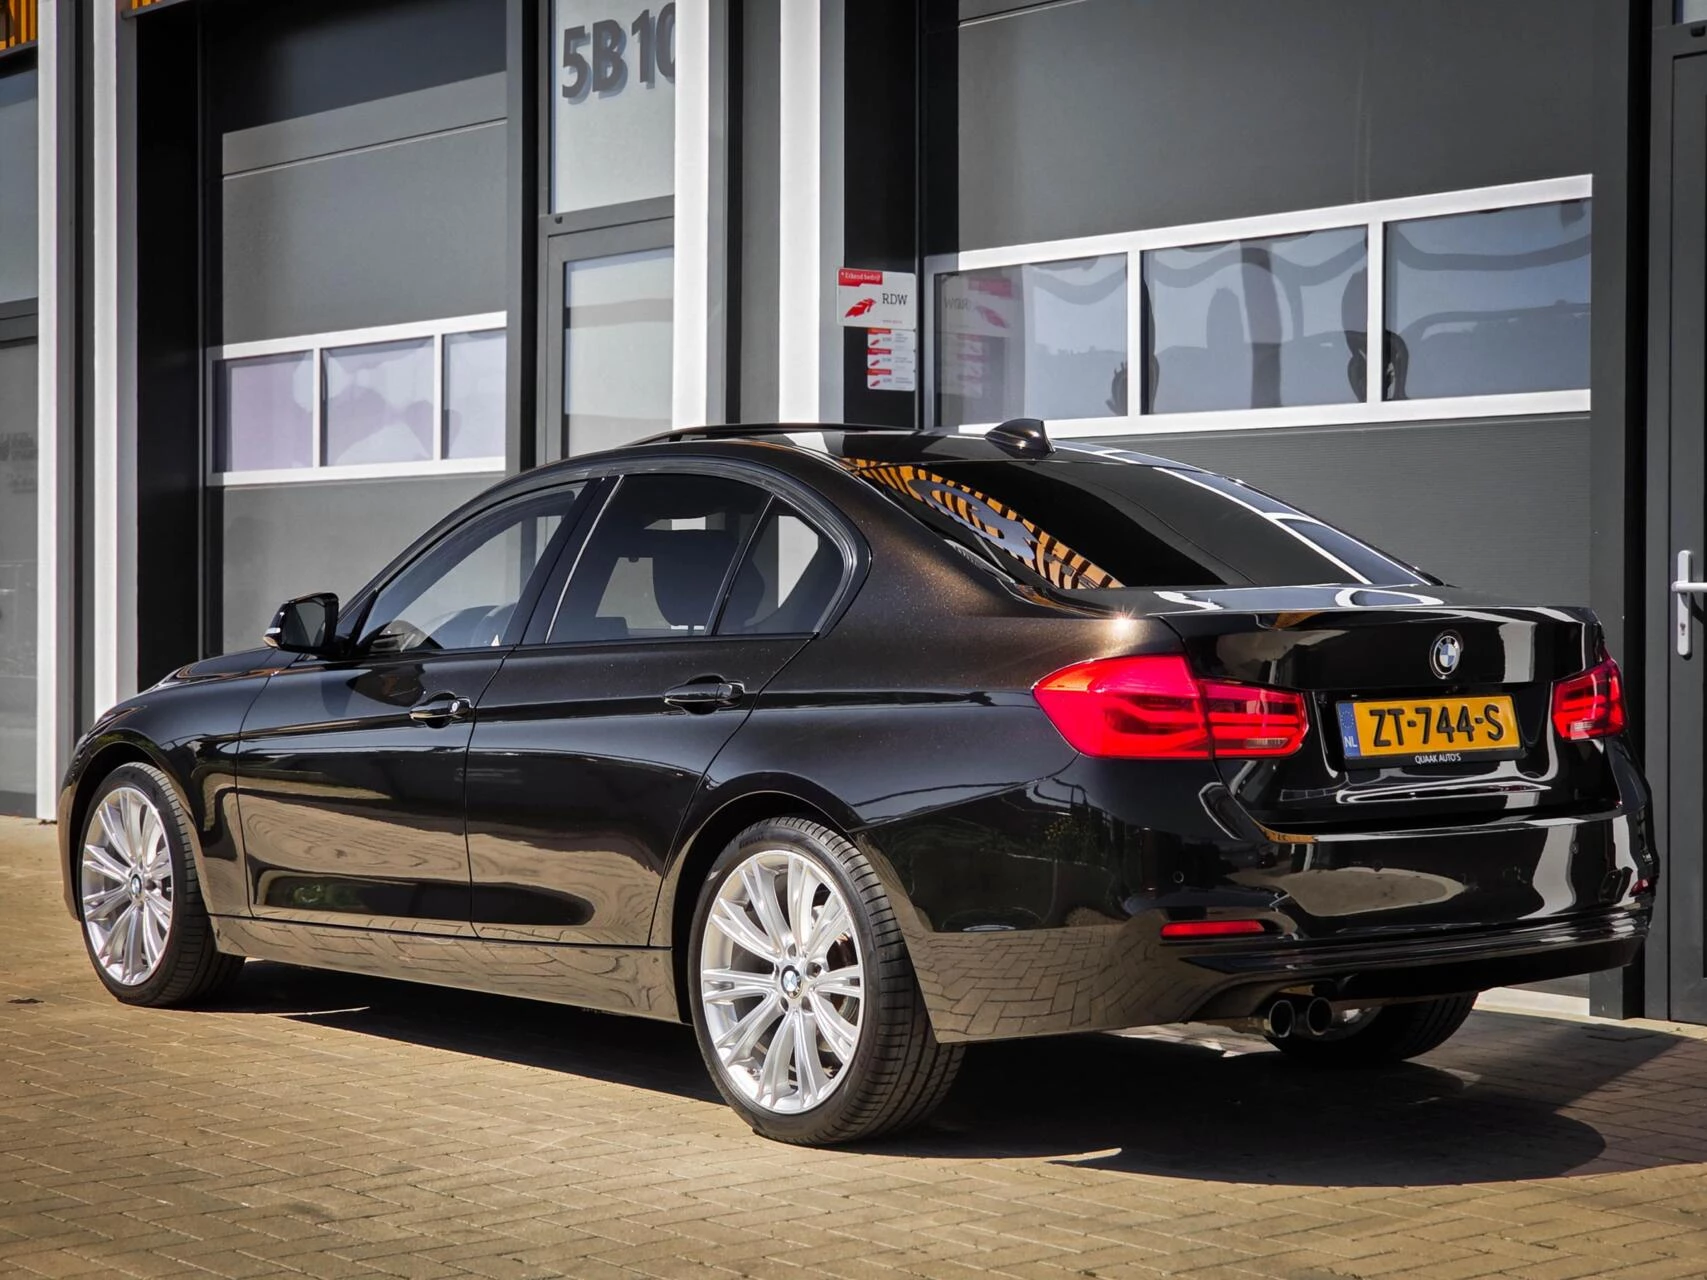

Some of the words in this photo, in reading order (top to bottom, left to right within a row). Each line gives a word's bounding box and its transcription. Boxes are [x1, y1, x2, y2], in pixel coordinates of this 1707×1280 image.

[882, 292, 908, 306] RDW
[1369, 704, 1504, 747] ZT-744-S
[1344, 735, 1358, 749] NL
[1415, 754, 1438, 765] QUAAK
